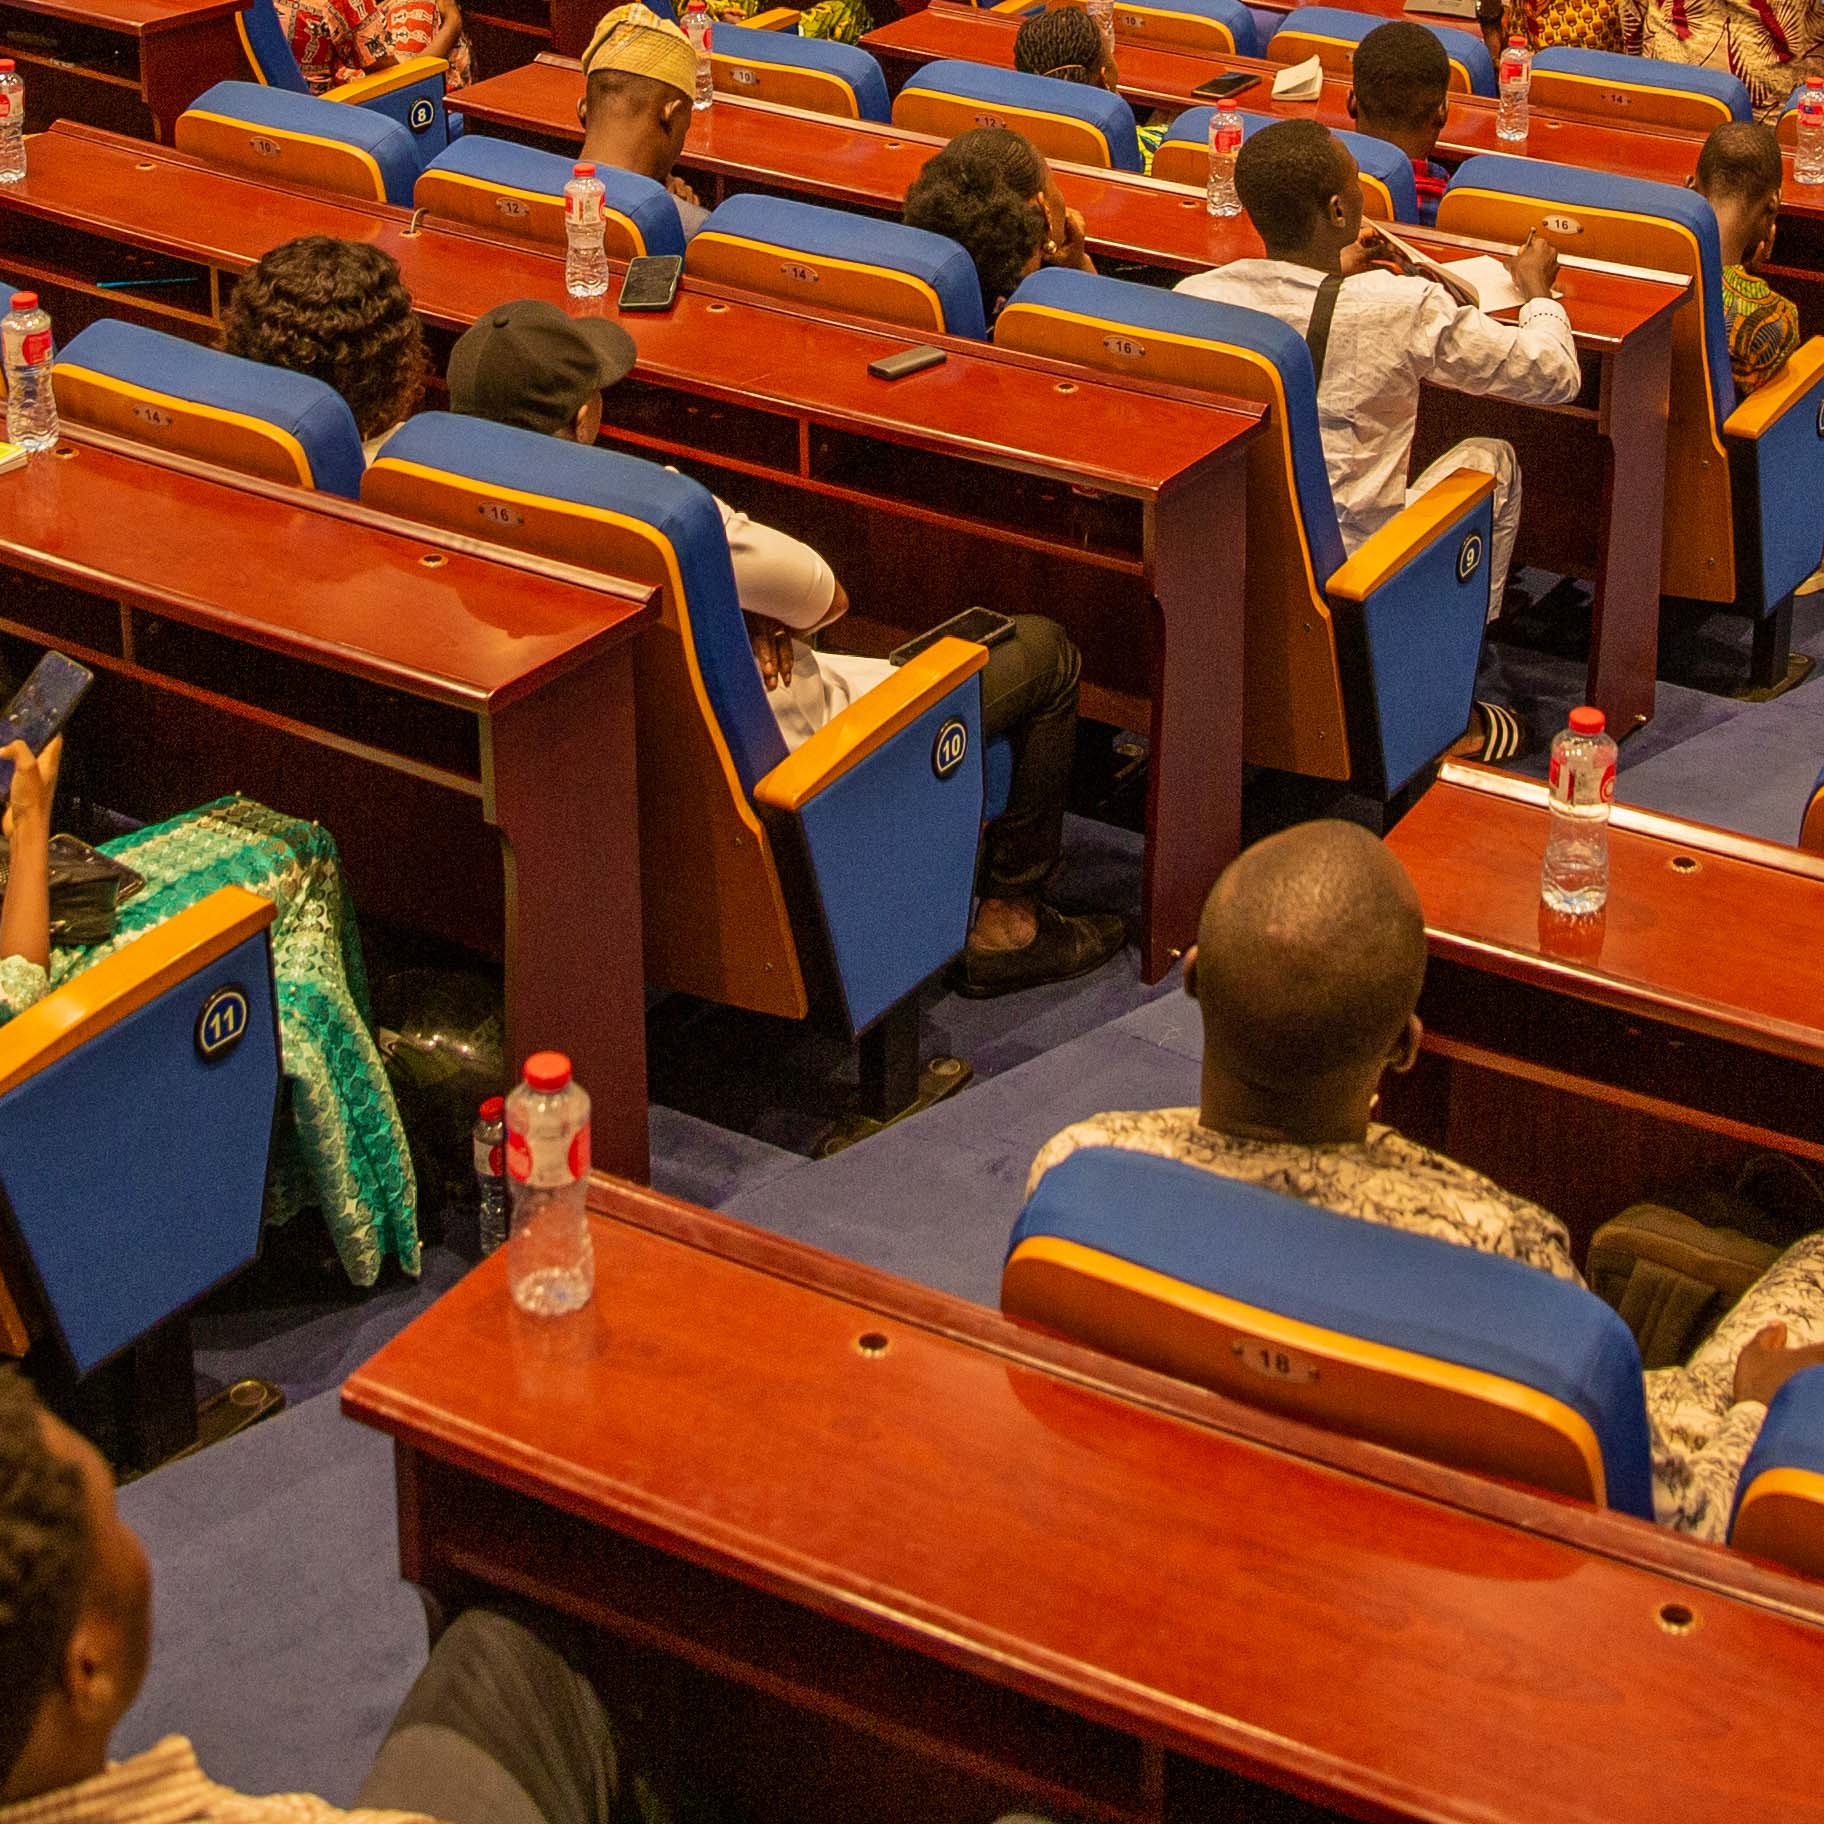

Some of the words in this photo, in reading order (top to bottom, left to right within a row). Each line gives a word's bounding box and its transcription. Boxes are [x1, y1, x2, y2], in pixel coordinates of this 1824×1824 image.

[1126, 16, 1136, 25] 10
[739, 71, 750, 81] 10
[1611, 94, 1622, 104] 14
[418, 107, 426, 120] 8
[984, 117, 995, 127] 12
[259, 142, 271, 153] 10
[507, 203, 519, 213] 12
[1555, 220, 1568, 230] 16
[793, 268, 806, 279] 14
[1116, 342, 1132, 353] 16
[145, 411, 160, 423] 14
[491, 508, 508, 521] 16
[1466, 547, 1474, 566] 9
[942, 733, 961, 762] 10
[209, 1004, 234, 1040] 11
[1259, 1350, 1292, 1374] 18
